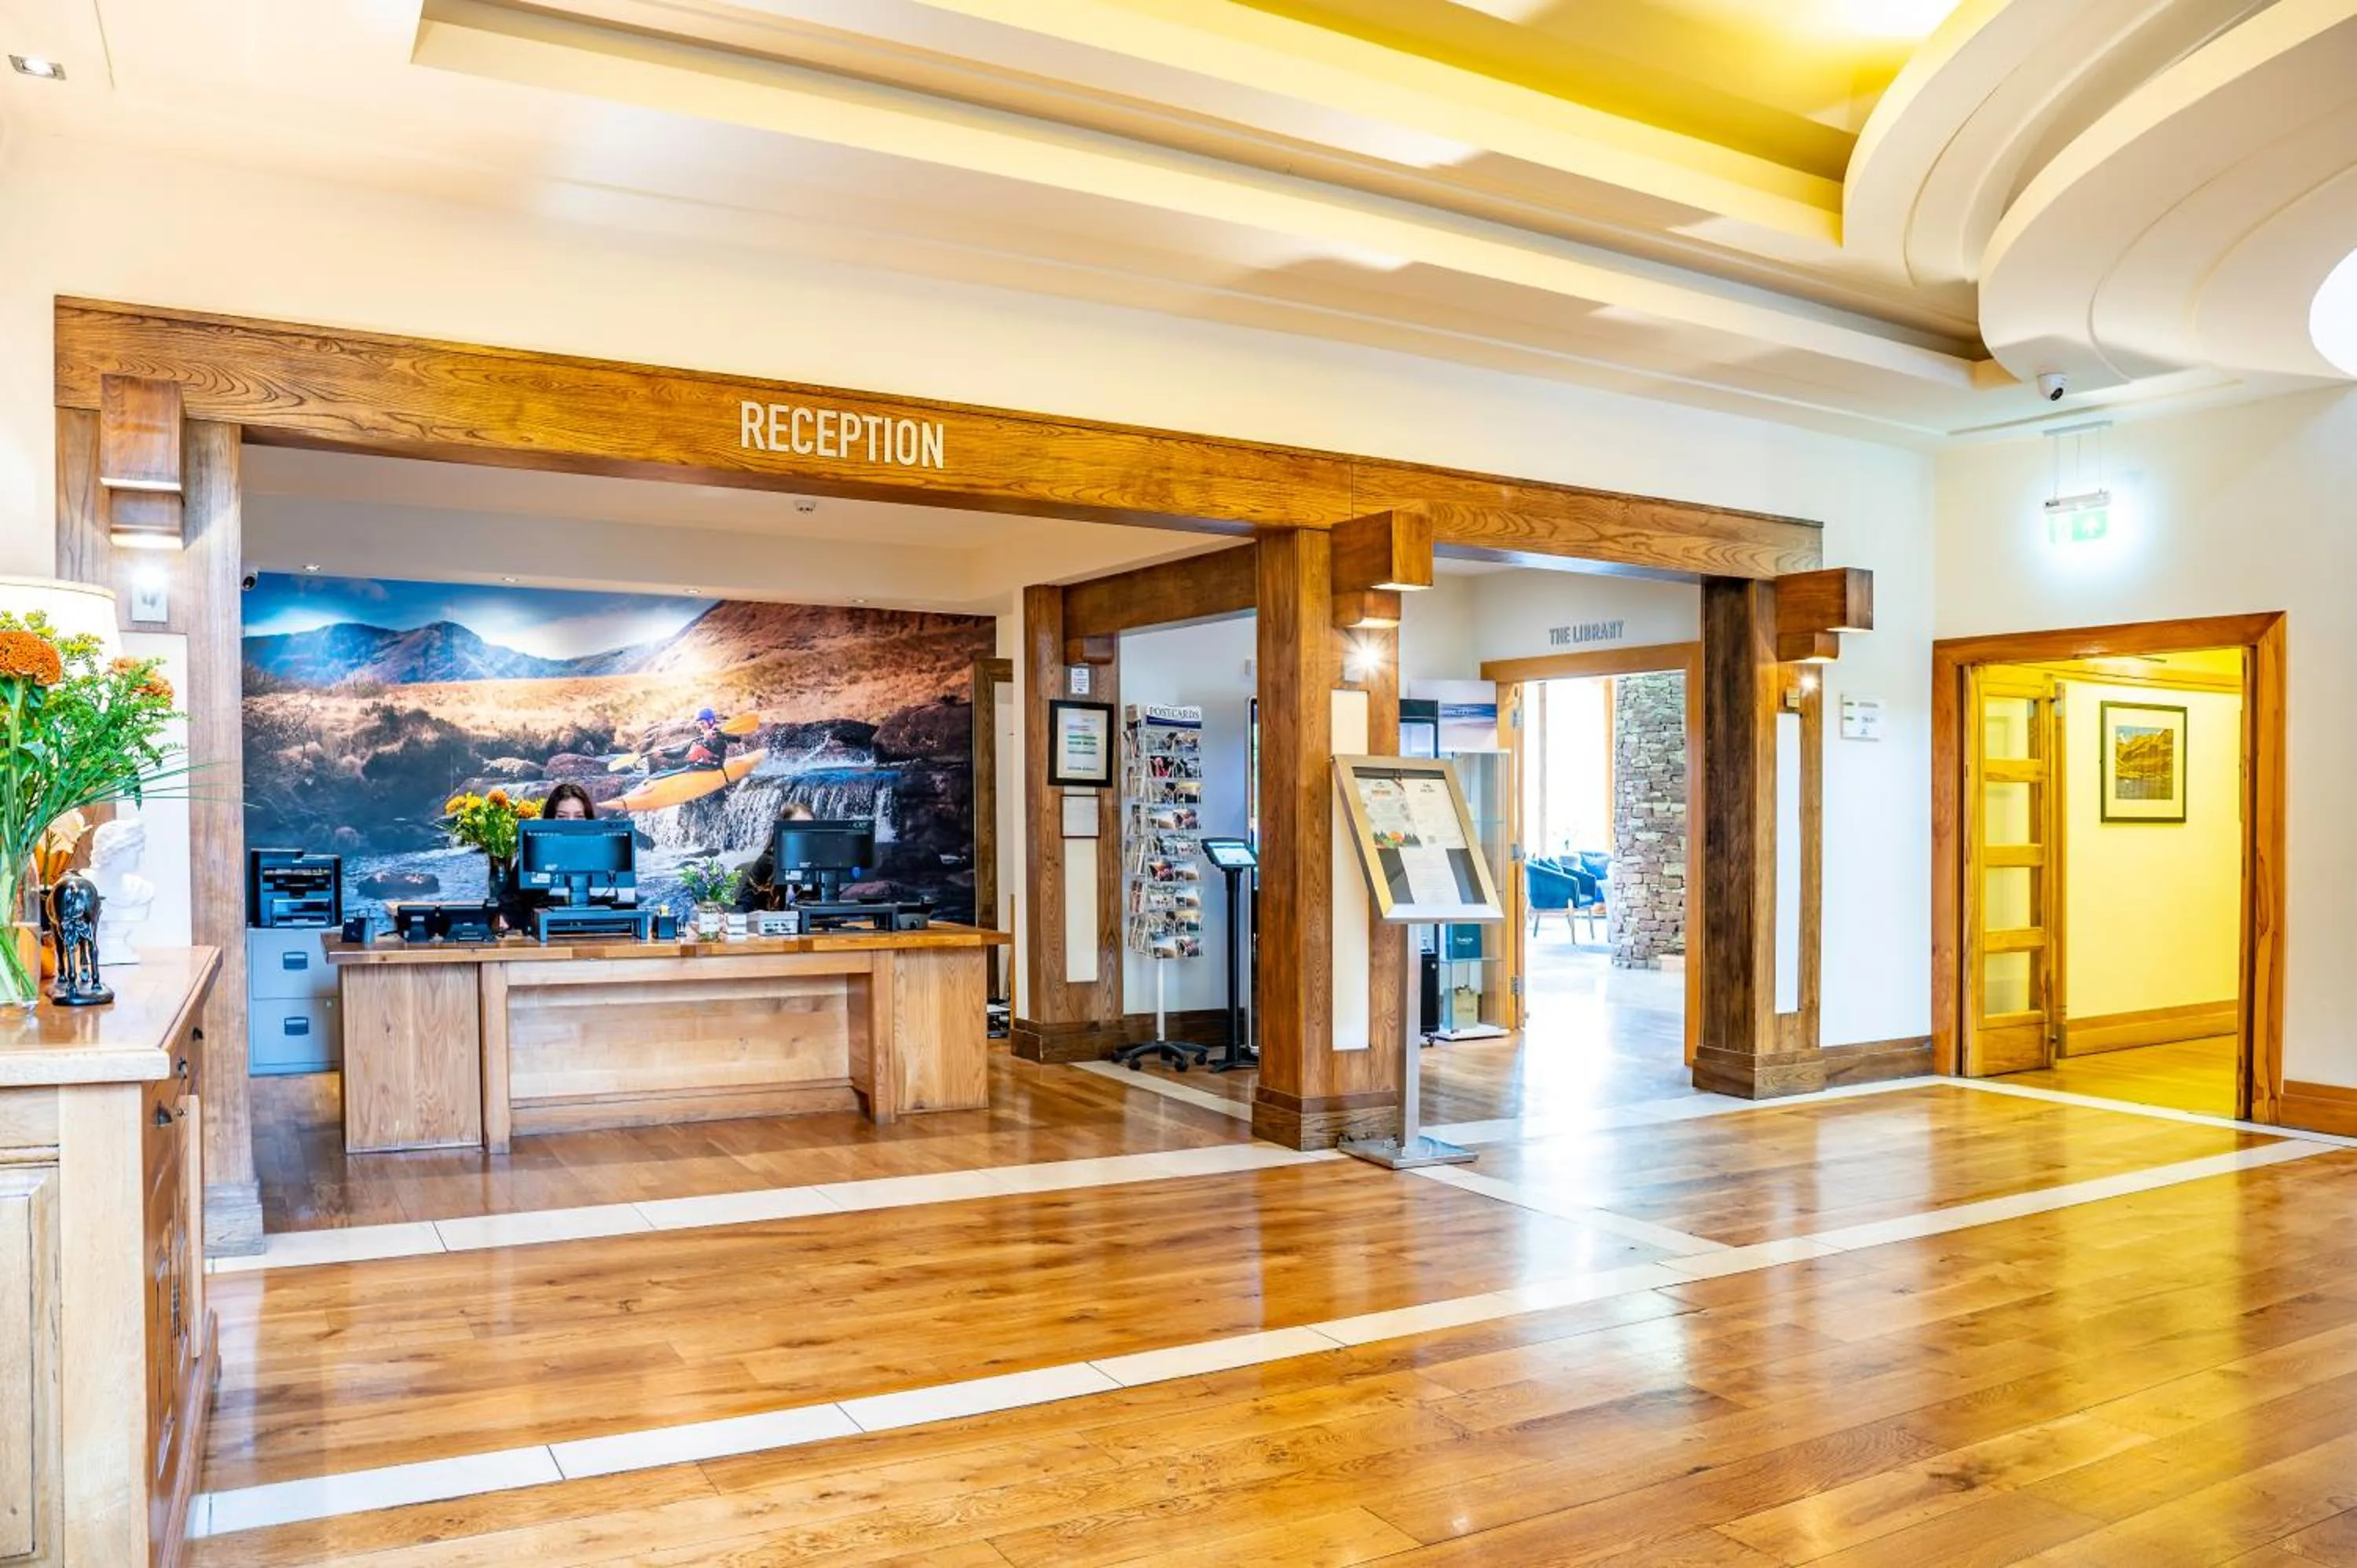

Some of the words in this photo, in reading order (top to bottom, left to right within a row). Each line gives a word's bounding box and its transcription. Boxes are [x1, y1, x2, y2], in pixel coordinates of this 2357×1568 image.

[740, 400, 944, 470] RECEPTION
[1549, 626, 1571, 645] THE
[1573, 620, 1624, 643] LIBRARY
[1149, 706, 1200, 720] POSTCARDS
